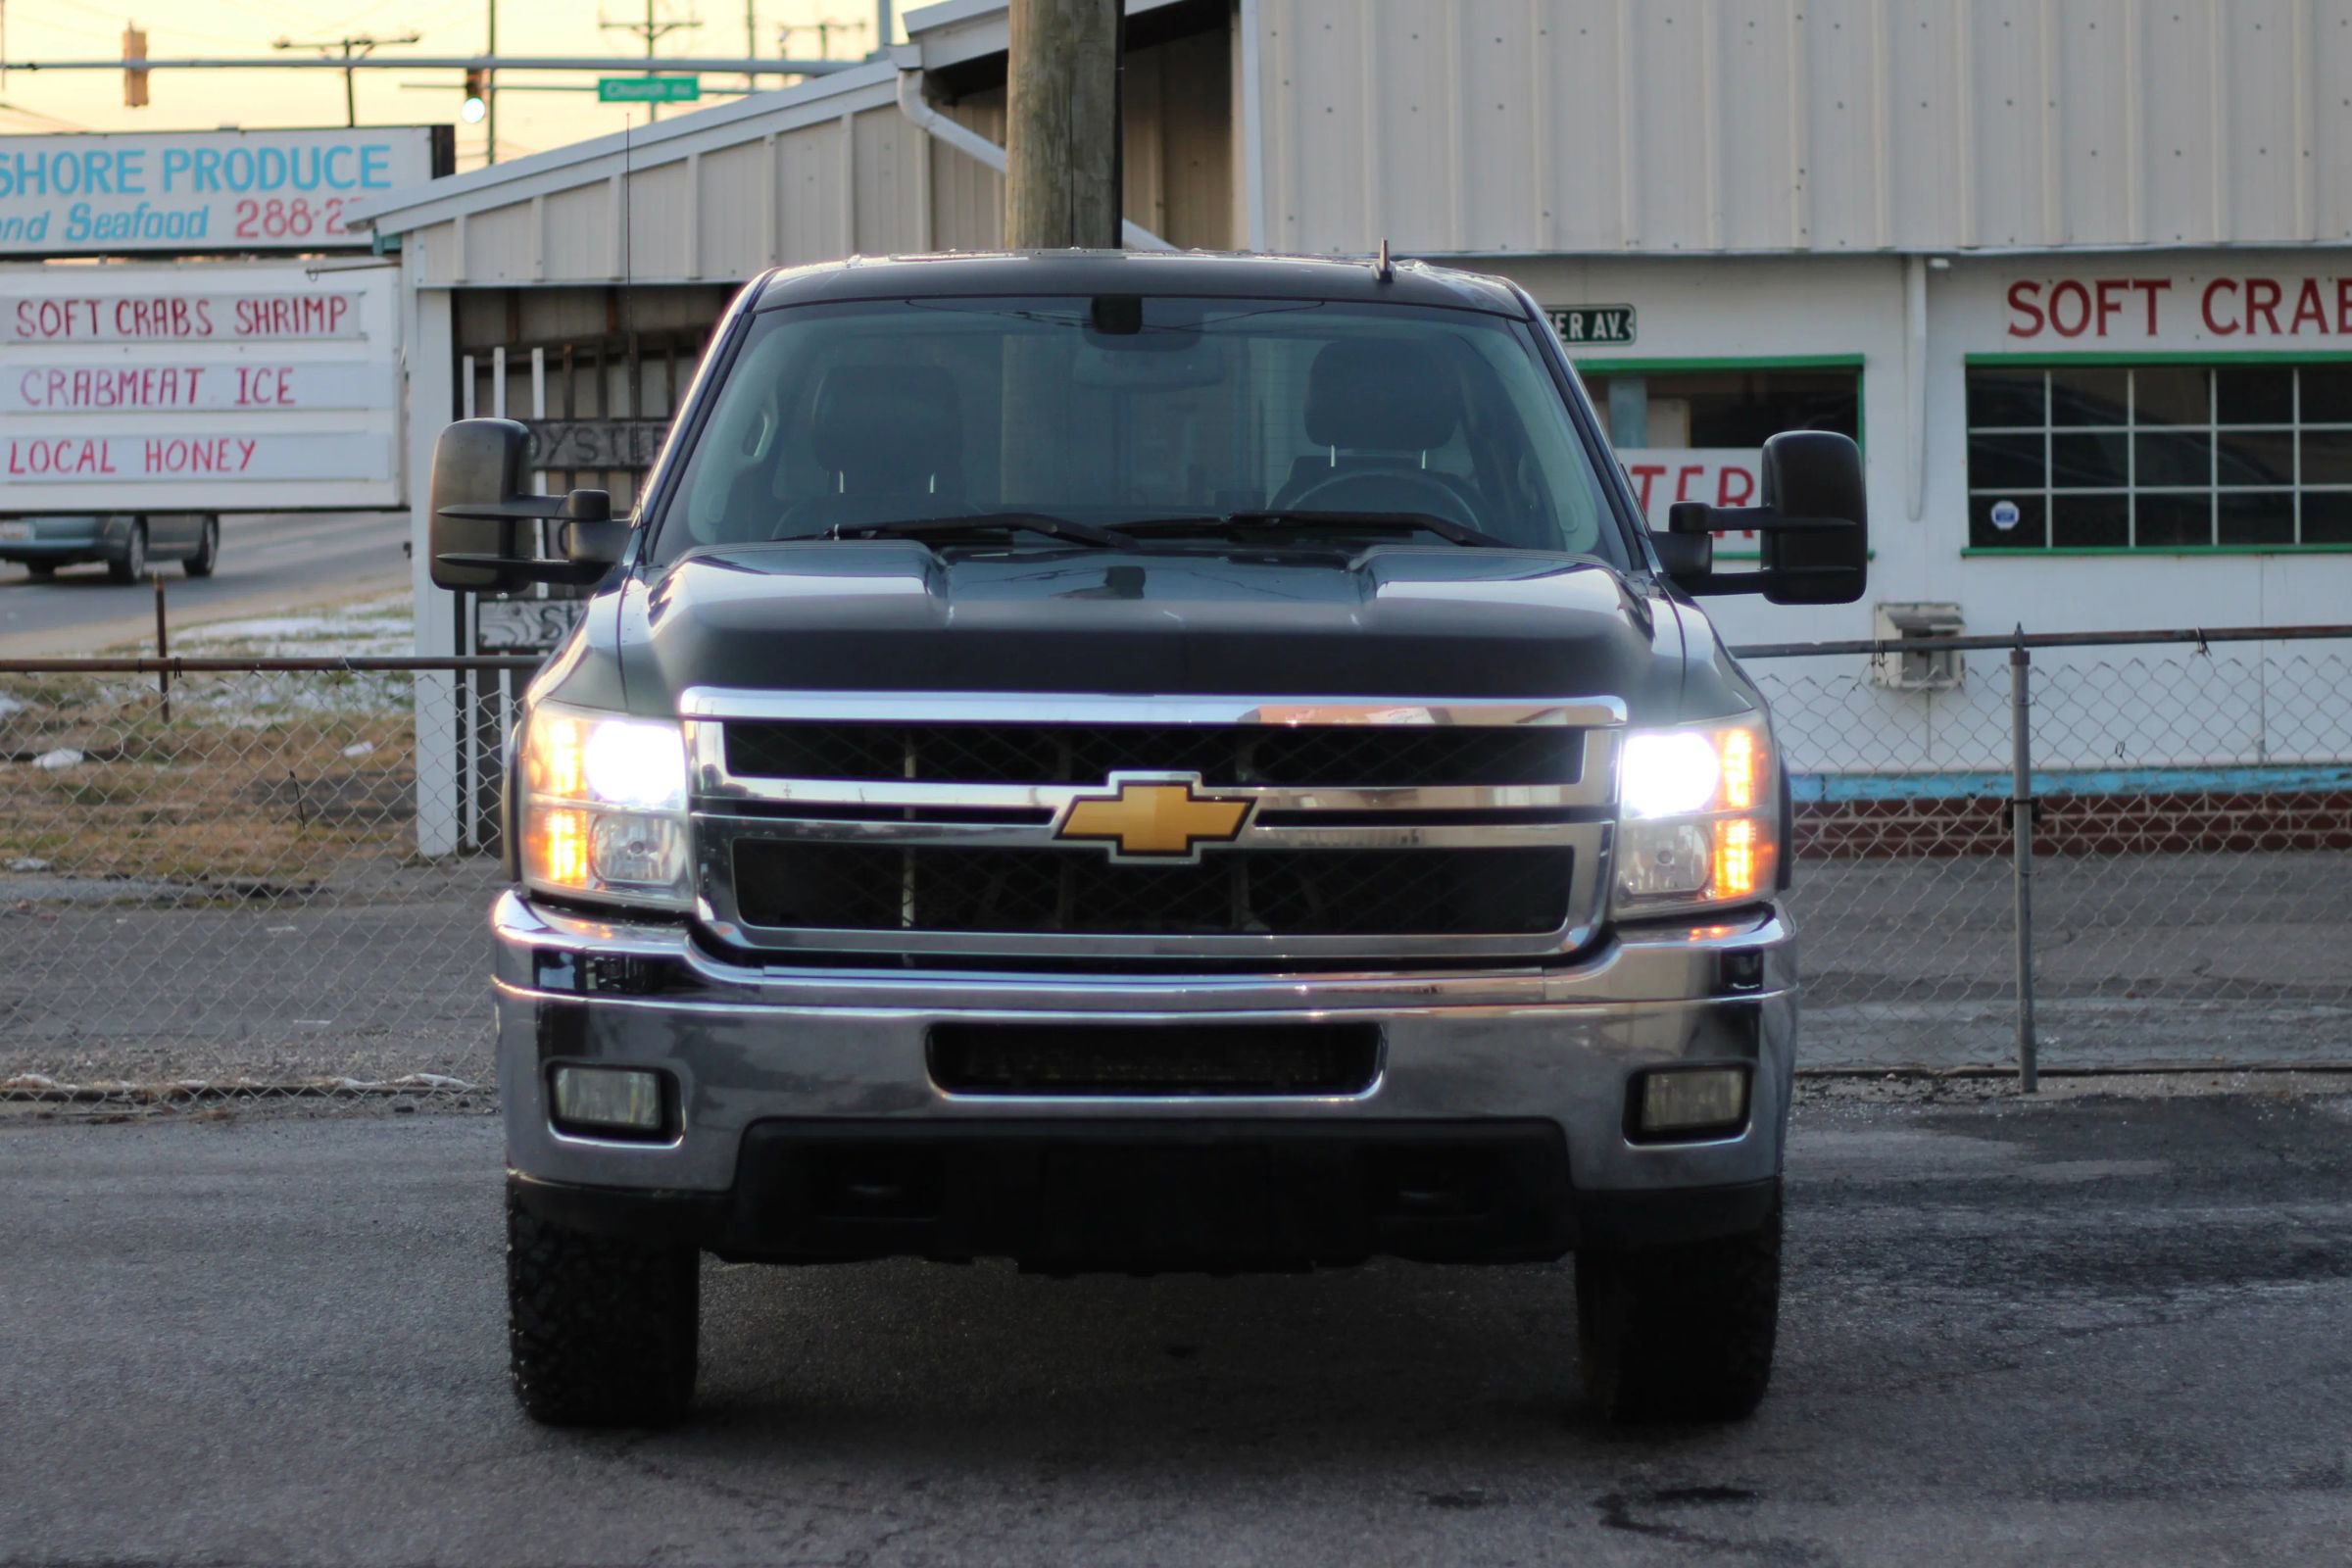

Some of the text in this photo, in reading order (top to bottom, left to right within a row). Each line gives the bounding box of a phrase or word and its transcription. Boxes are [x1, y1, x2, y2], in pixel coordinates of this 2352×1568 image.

[163, 144, 392, 192] PRODUCE
[0, 197, 362, 243] nd Seafood 288-2
[16, 295, 348, 338] SOFT CRABS SHRIMP
[1545, 313, 1585, 340] ER
[2007, 278, 2172, 338] SOFT
[20, 367, 296, 407] CRABMEAT ICE
[8, 438, 257, 474] LOCAL HONEY
